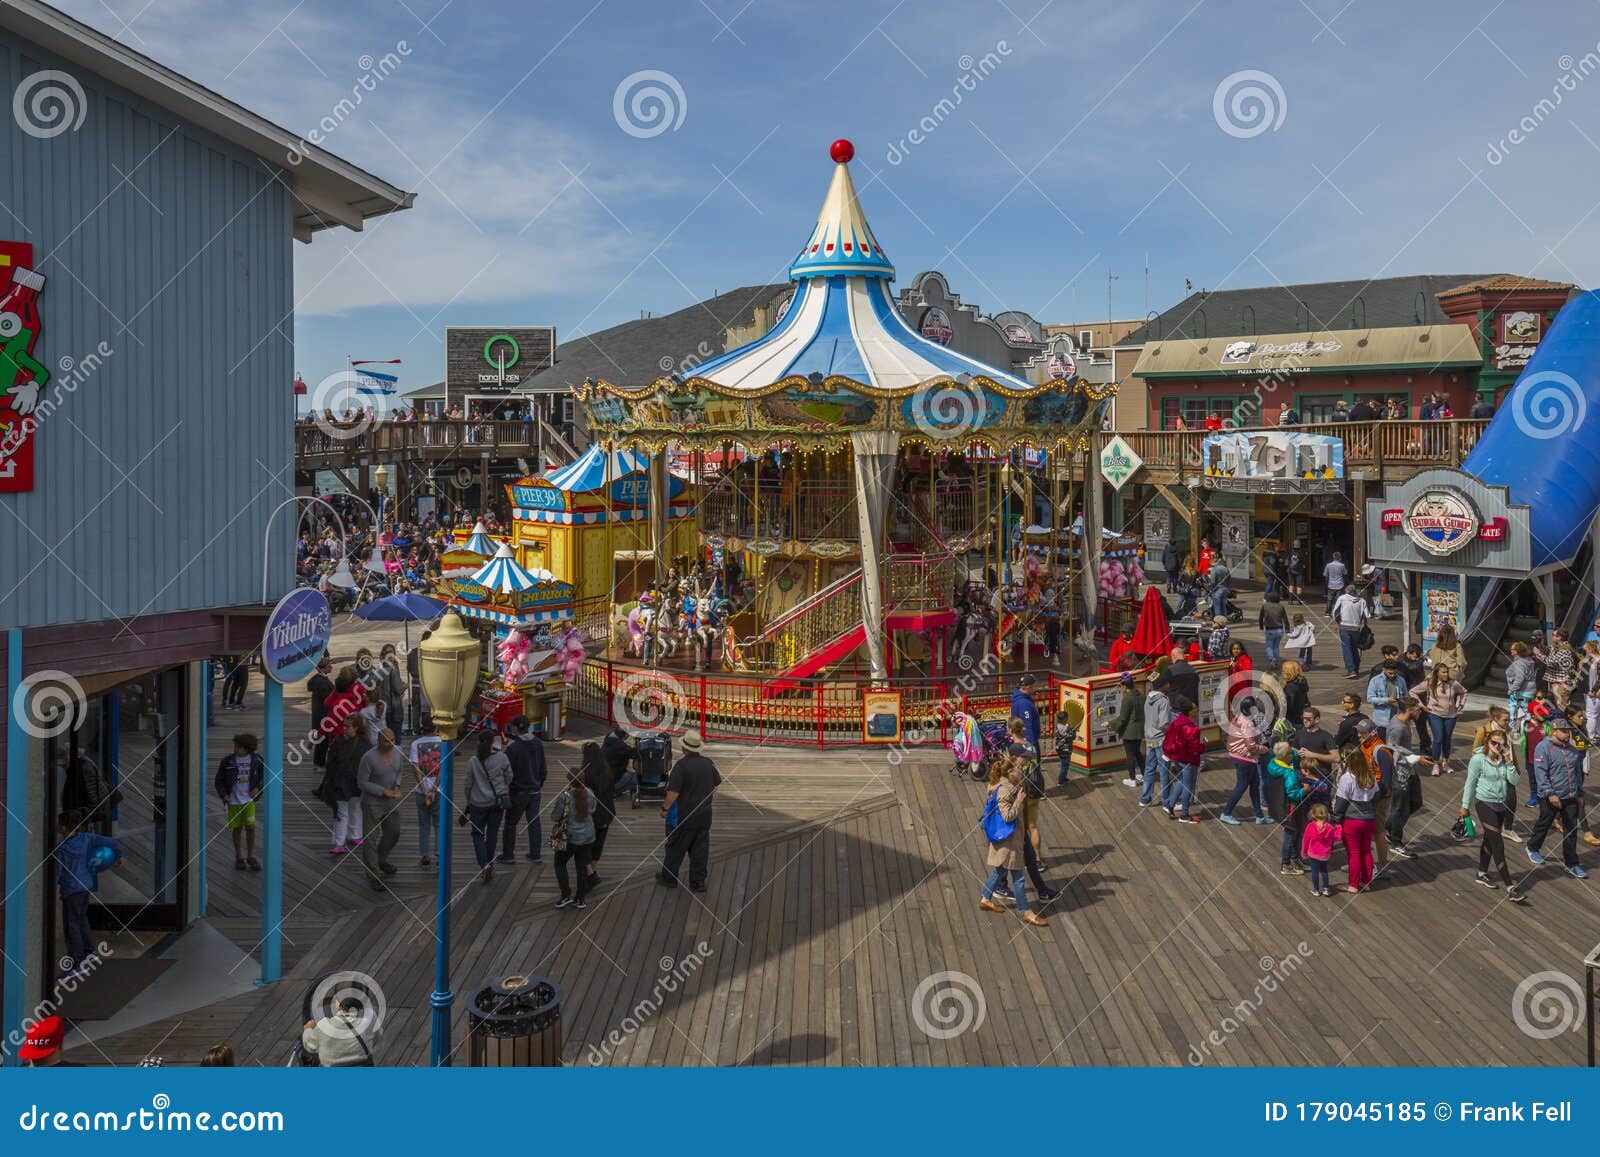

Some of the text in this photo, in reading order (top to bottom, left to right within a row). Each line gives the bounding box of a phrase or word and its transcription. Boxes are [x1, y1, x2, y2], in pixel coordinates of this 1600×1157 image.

[1248, 436, 1287, 472] 7D
[1203, 477, 1341, 493] EXPERIENCE
[520, 487, 556, 506] PIER 39
[1384, 512, 1403, 522] OPEN
[1411, 517, 1471, 529] BUBBA GUMP
[1480, 527, 1501, 537] LATE
[271, 612, 318, 650] Vitality
